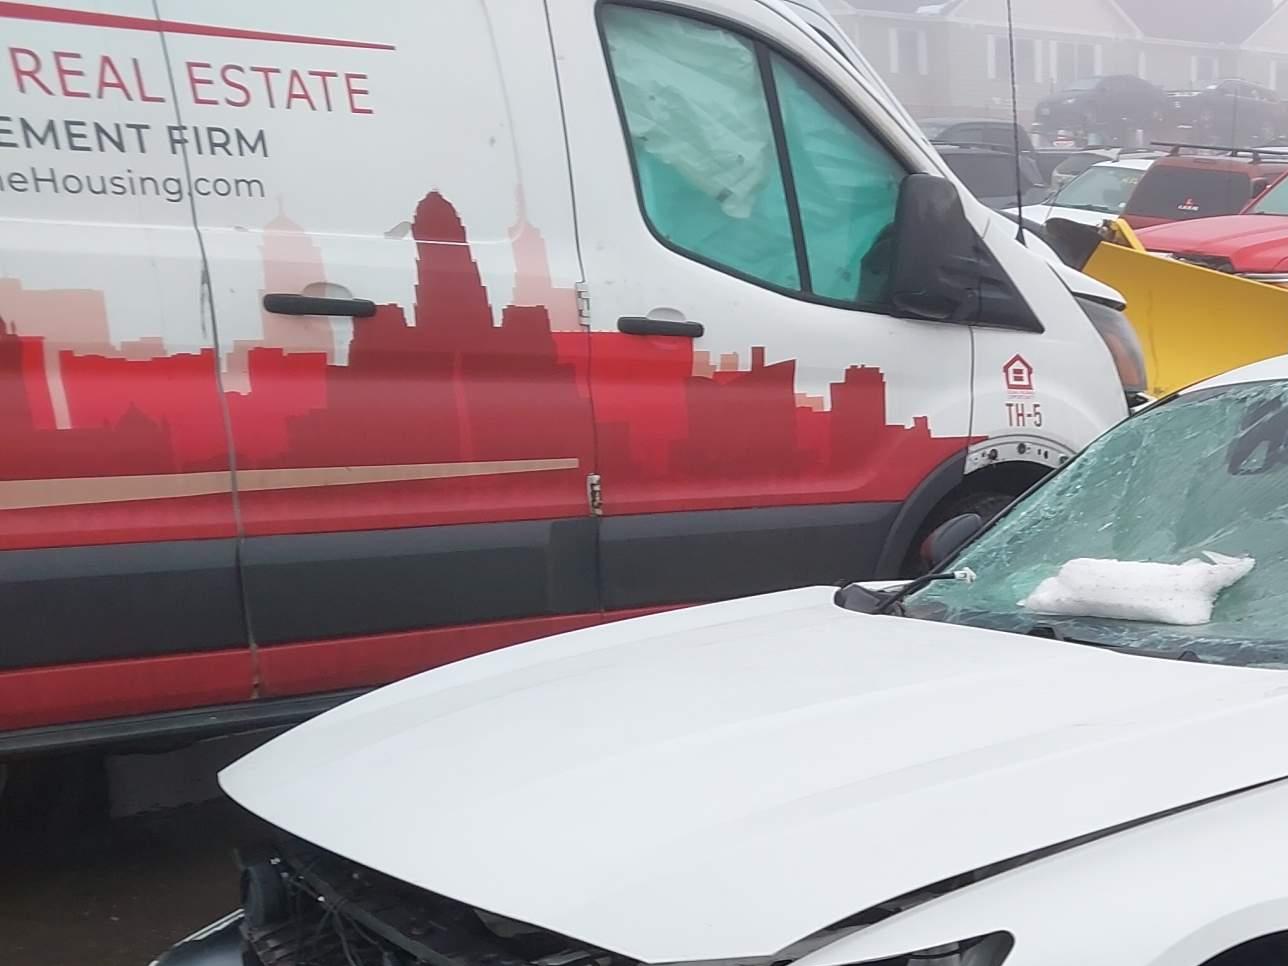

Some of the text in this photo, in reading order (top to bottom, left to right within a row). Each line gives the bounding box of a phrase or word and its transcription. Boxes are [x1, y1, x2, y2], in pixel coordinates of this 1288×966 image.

[7, 46, 374, 115] REAL ESTATE
[167, 125, 270, 158] FIRM
[0, 166, 265, 203] eHousing.com
[1005, 403, 1043, 427] TH-5
